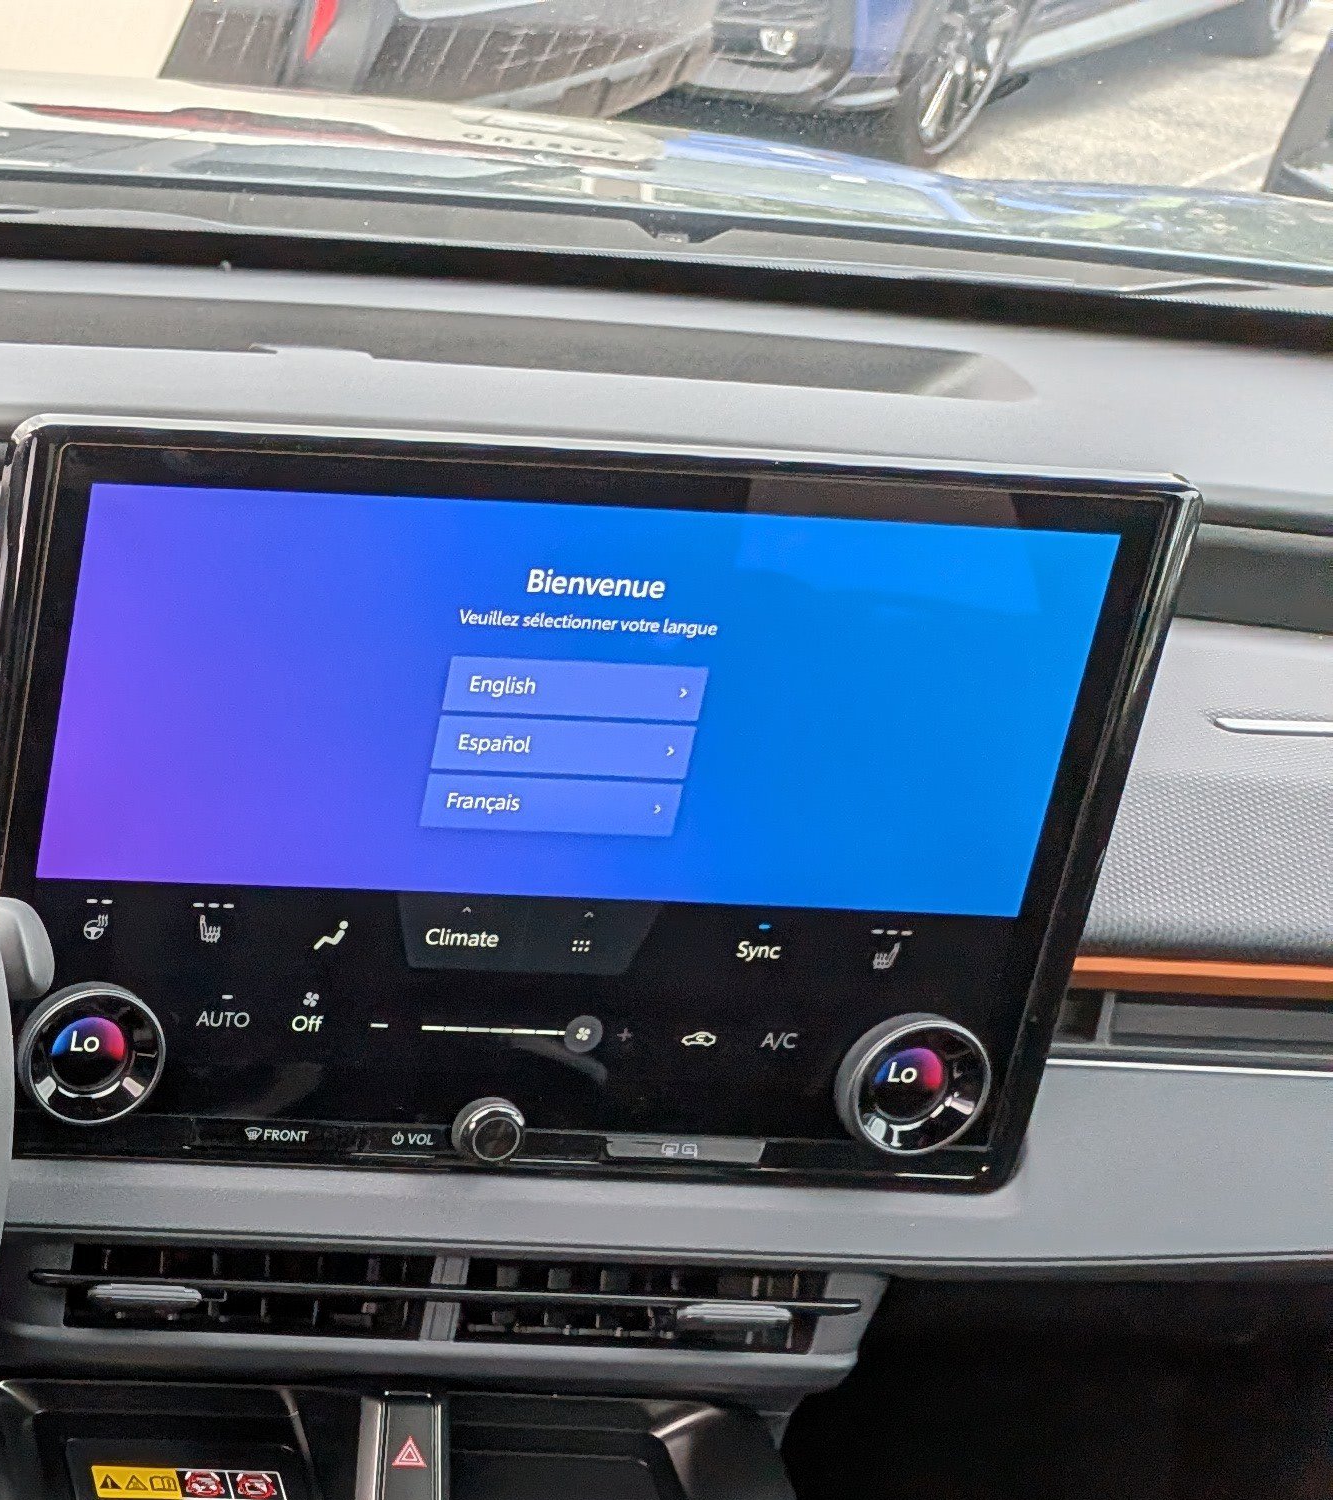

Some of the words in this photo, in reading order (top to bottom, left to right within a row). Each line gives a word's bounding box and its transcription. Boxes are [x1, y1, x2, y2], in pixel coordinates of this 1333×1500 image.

[526, 568, 666, 599] Bienvenue
[459, 609, 519, 628] Veuillez
[522, 612, 618, 631] sélectionner
[620, 620, 660, 633] votre
[662, 618, 718, 638] langue
[469, 675, 536, 698] English
[457, 733, 531, 755] Español
[446, 792, 521, 814] Français
[425, 928, 500, 949] Climate
[736, 940, 782, 962] Sync
[195, 1010, 250, 1028] AUTO
[291, 1014, 324, 1033] Off
[69, 1030, 100, 1053] Lo
[760, 1031, 799, 1051] A/C
[887, 1062, 918, 1085] Lo
[263, 1129, 309, 1143] FRONT
[407, 1133, 435, 1146] VOL
